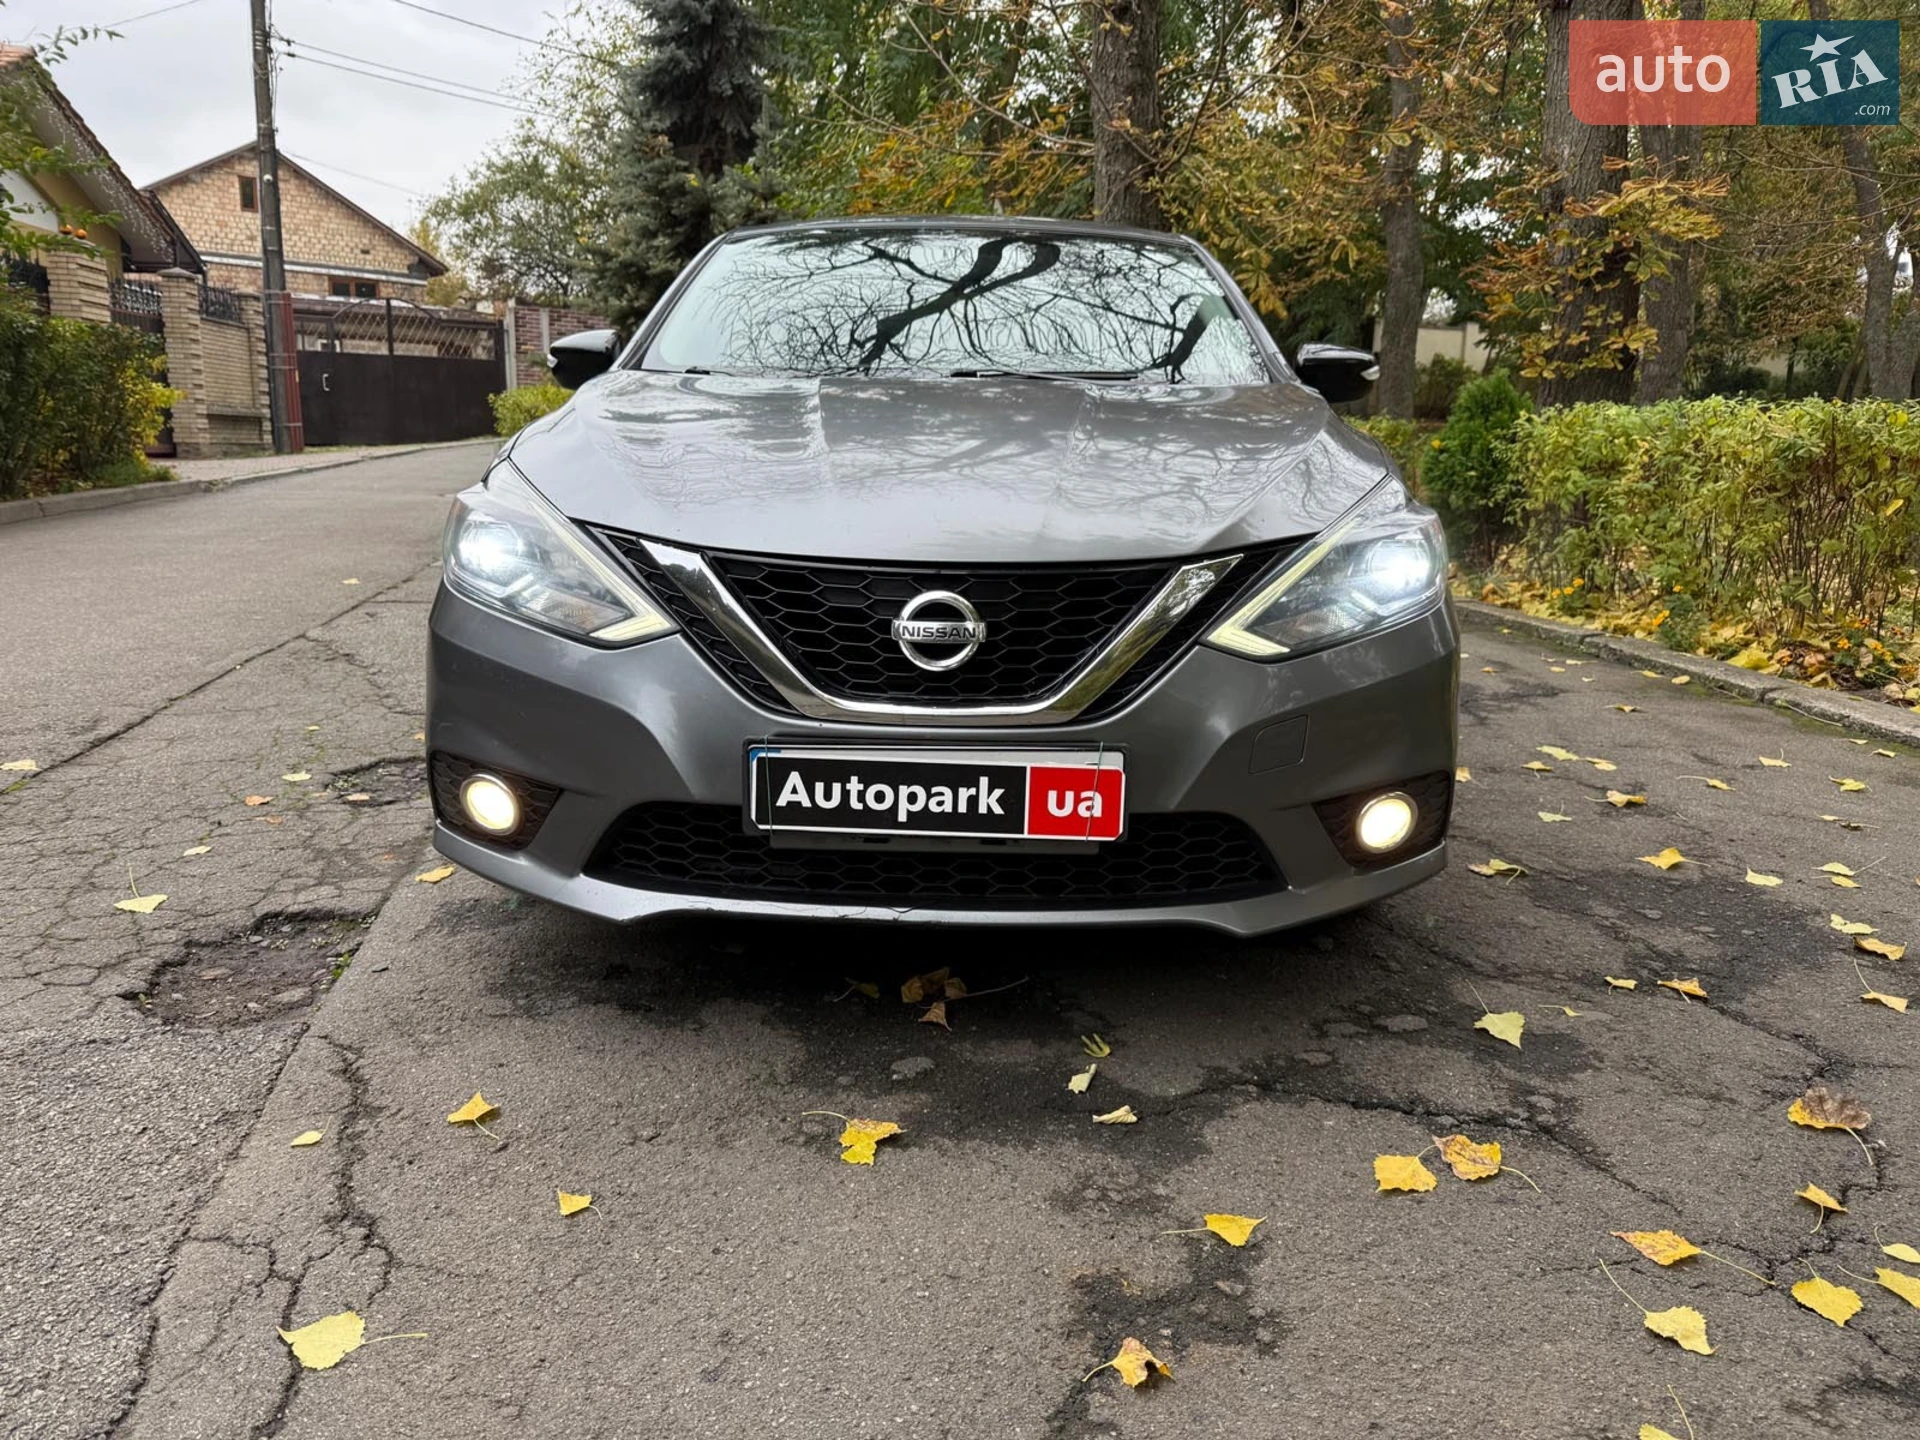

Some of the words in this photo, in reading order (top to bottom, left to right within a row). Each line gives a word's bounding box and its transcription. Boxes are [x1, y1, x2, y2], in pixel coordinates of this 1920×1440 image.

[901, 624, 977, 639] NISSAN
[775, 770, 1006, 823] Autopark
[1046, 788, 1103, 818] ua
